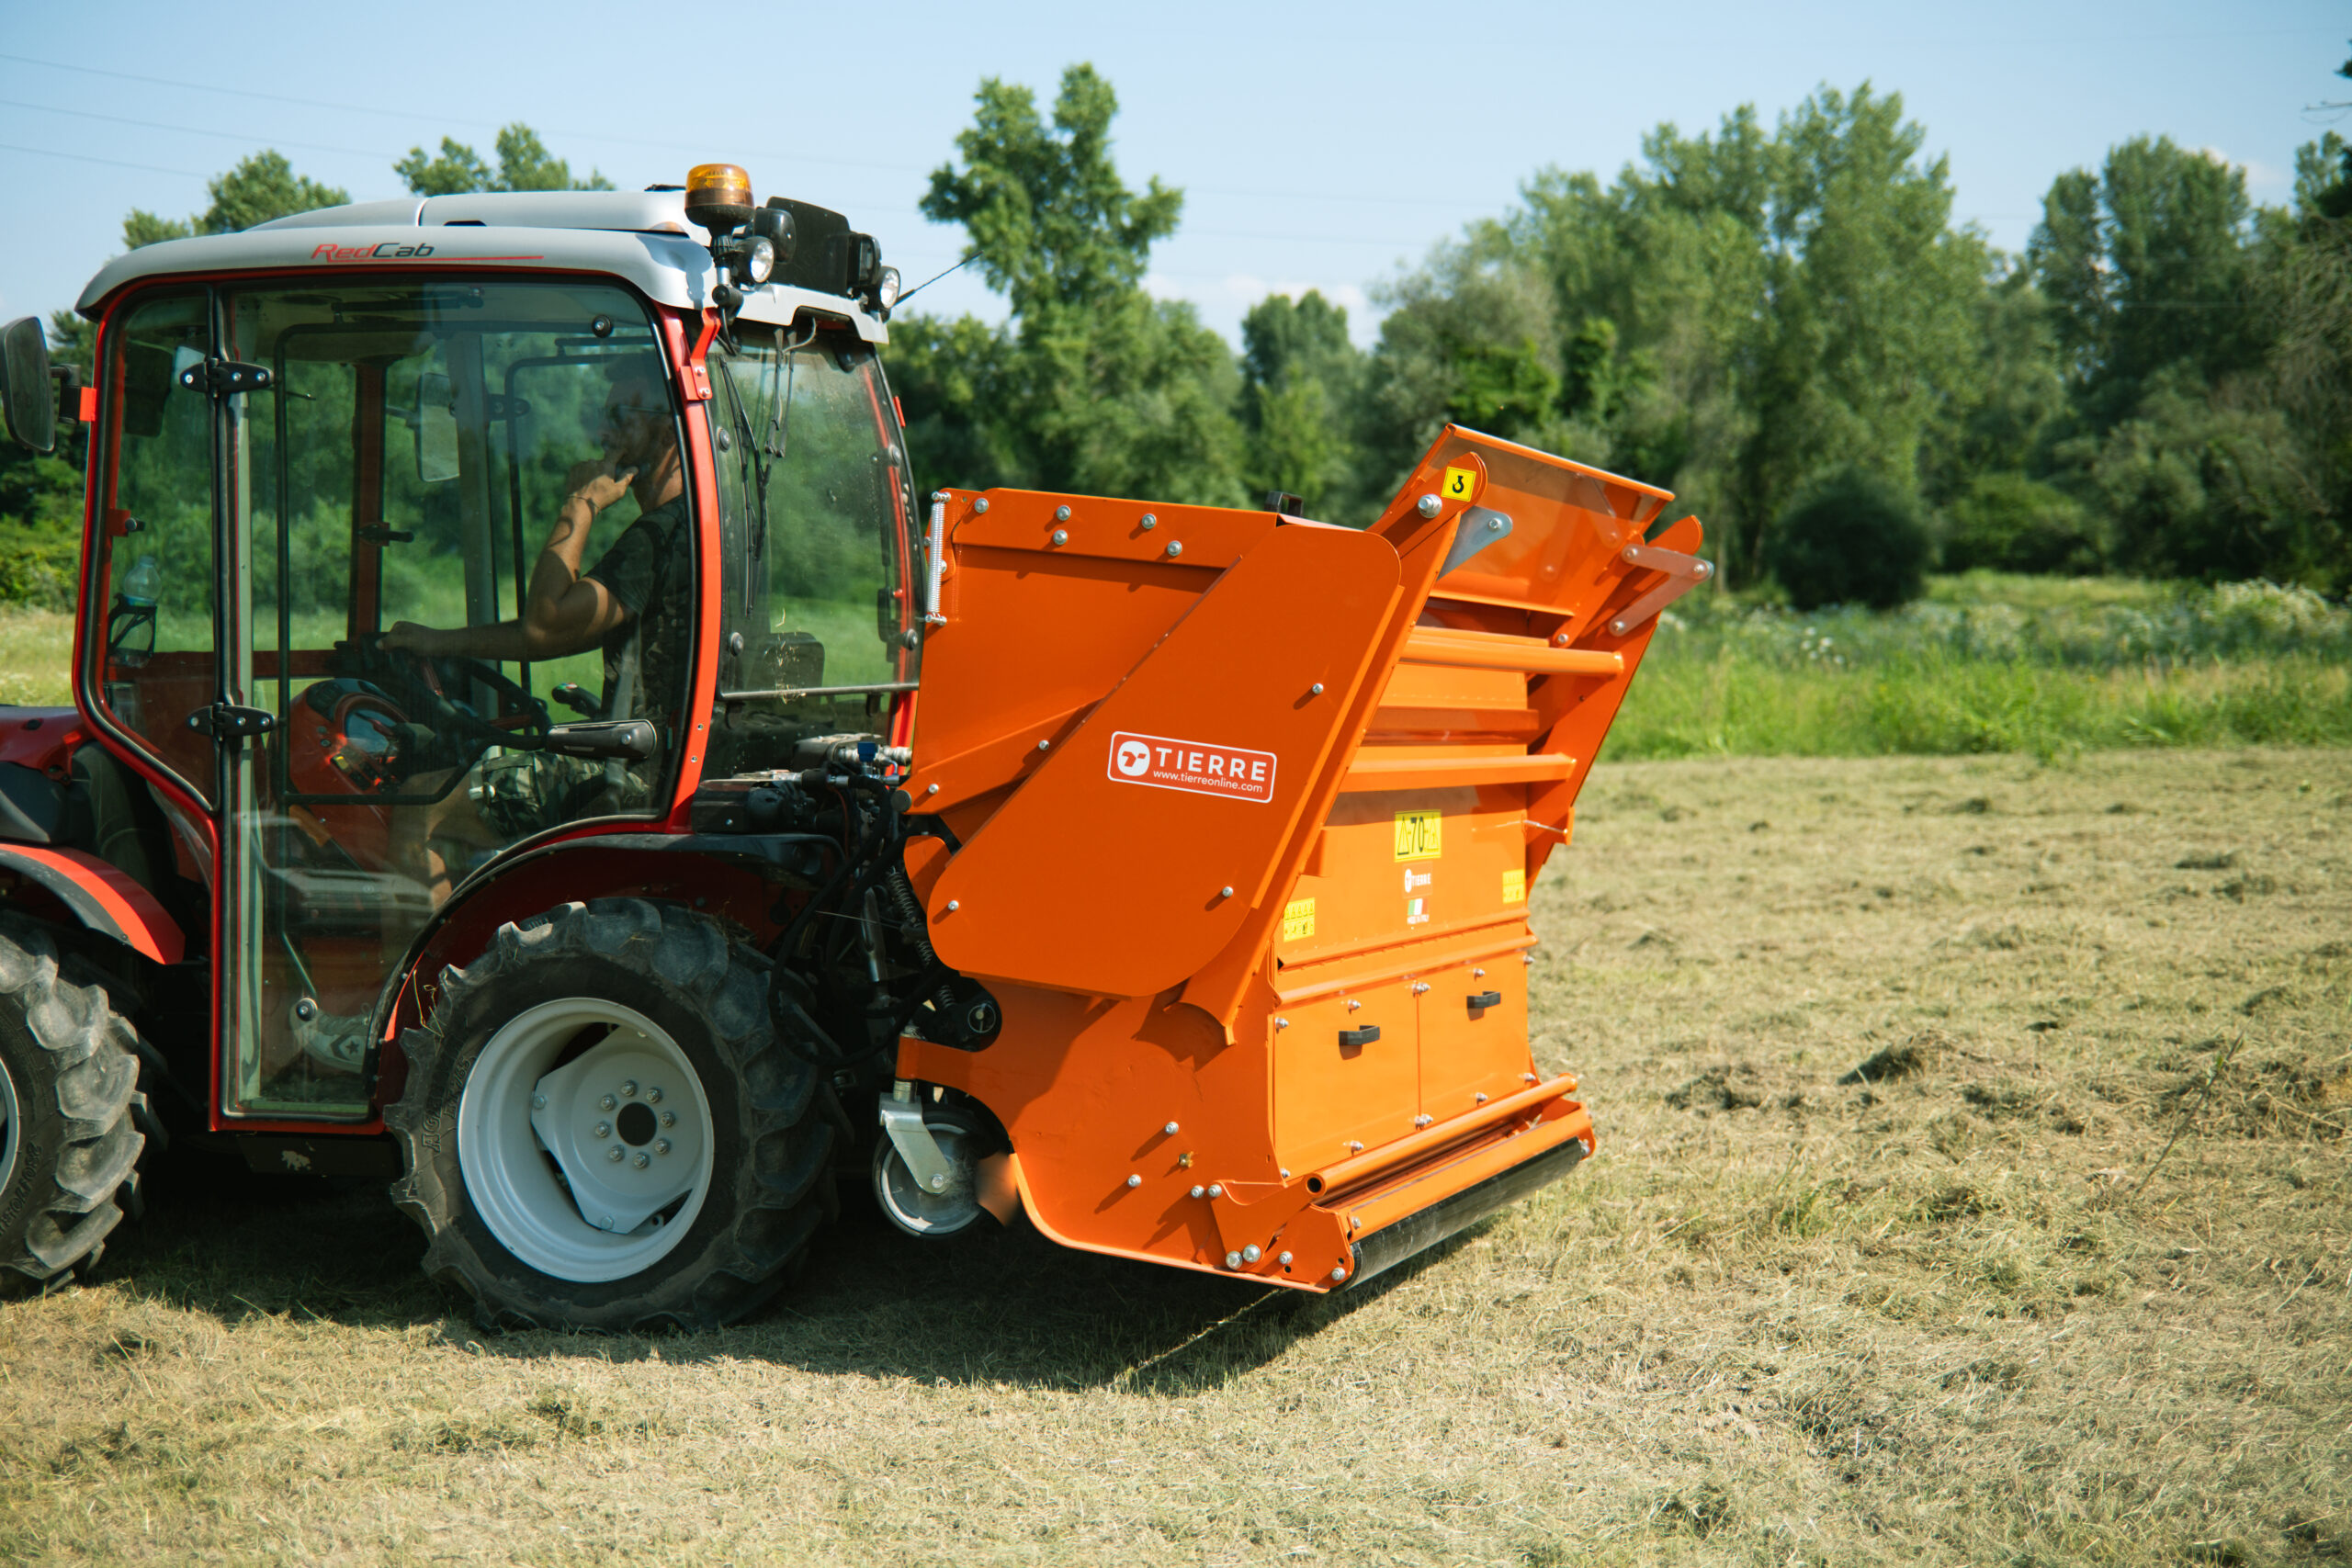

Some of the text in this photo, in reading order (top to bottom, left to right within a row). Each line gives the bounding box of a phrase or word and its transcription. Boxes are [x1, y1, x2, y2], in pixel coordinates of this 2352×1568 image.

[311, 242, 435, 263] RedCab
[1155, 746, 1267, 782] TIERRE
[1153, 769, 1263, 793] www.tierreonline.com
